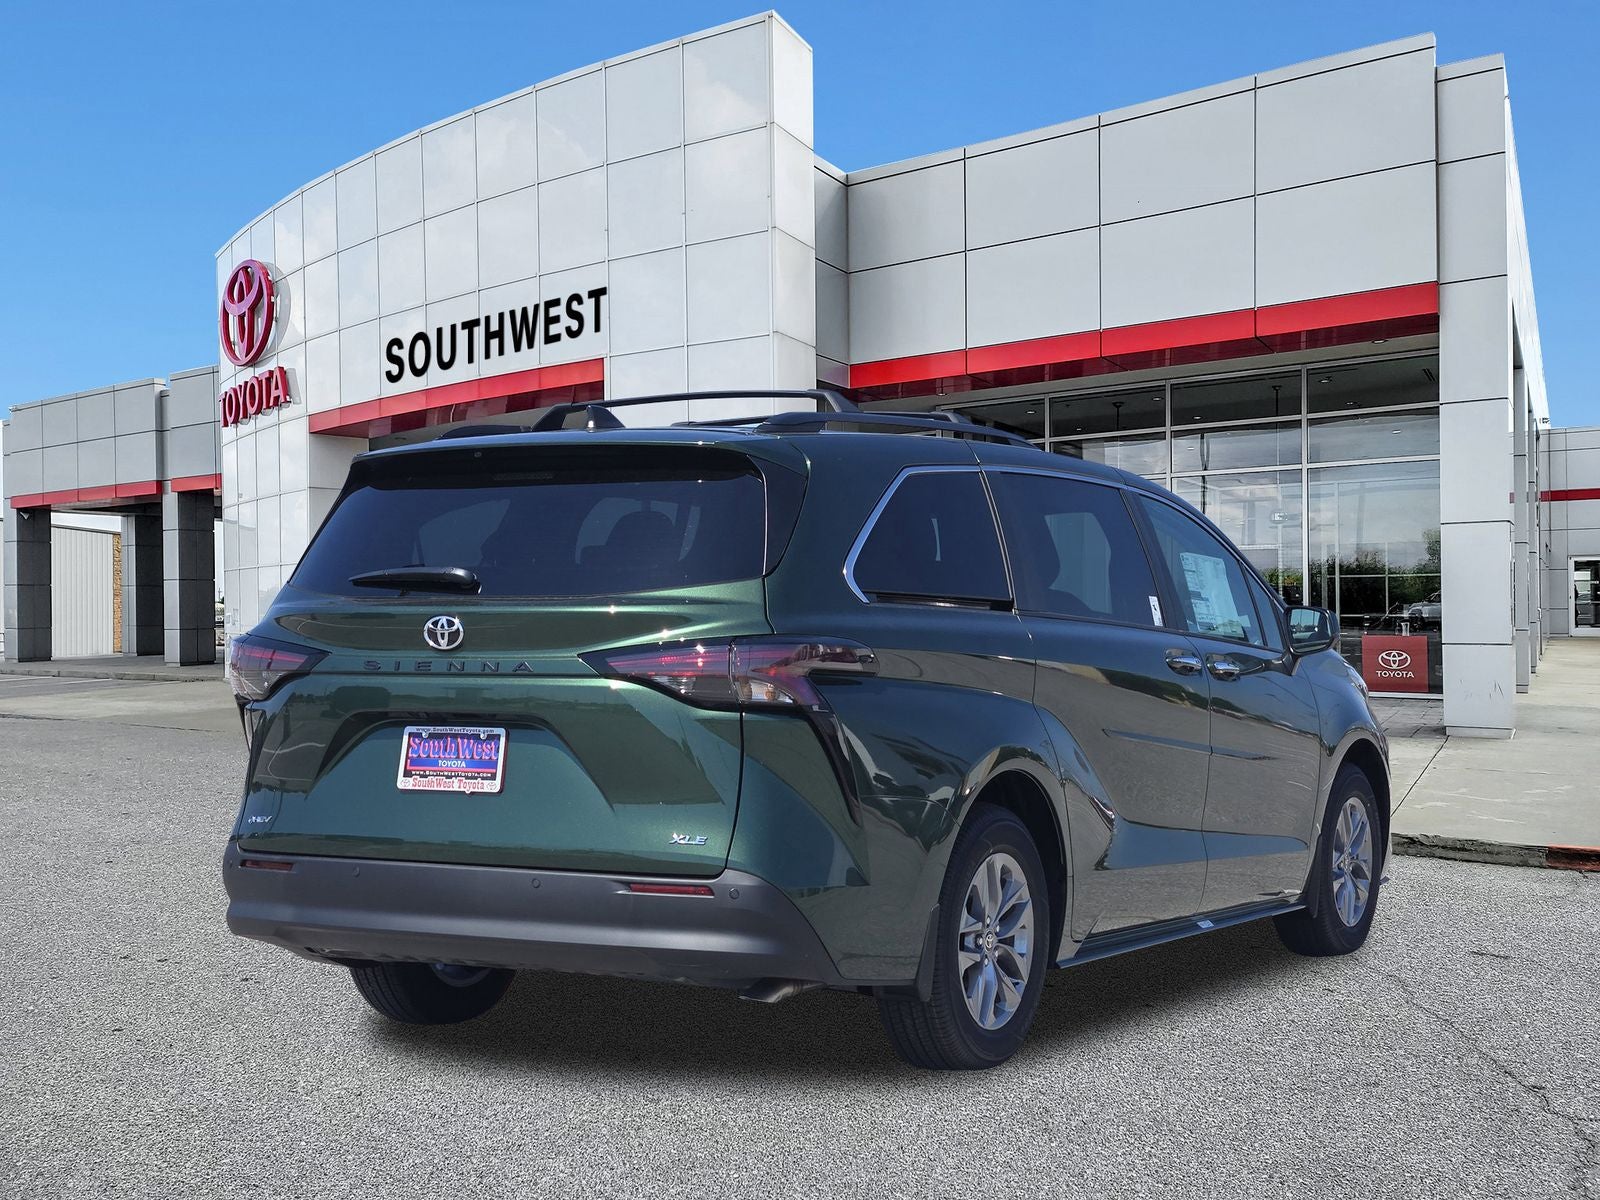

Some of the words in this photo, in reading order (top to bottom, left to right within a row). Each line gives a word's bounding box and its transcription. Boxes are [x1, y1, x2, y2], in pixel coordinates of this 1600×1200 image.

[385, 286, 607, 384] SOUTHWEST
[219, 366, 290, 428] TOYOTA
[363, 660, 534, 673] SIENNA
[438, 760, 466, 768] TOYOTA
[412, 777, 455, 789] SouthWest
[457, 780, 485, 791] Toyota
[669, 832, 708, 845] XLE
